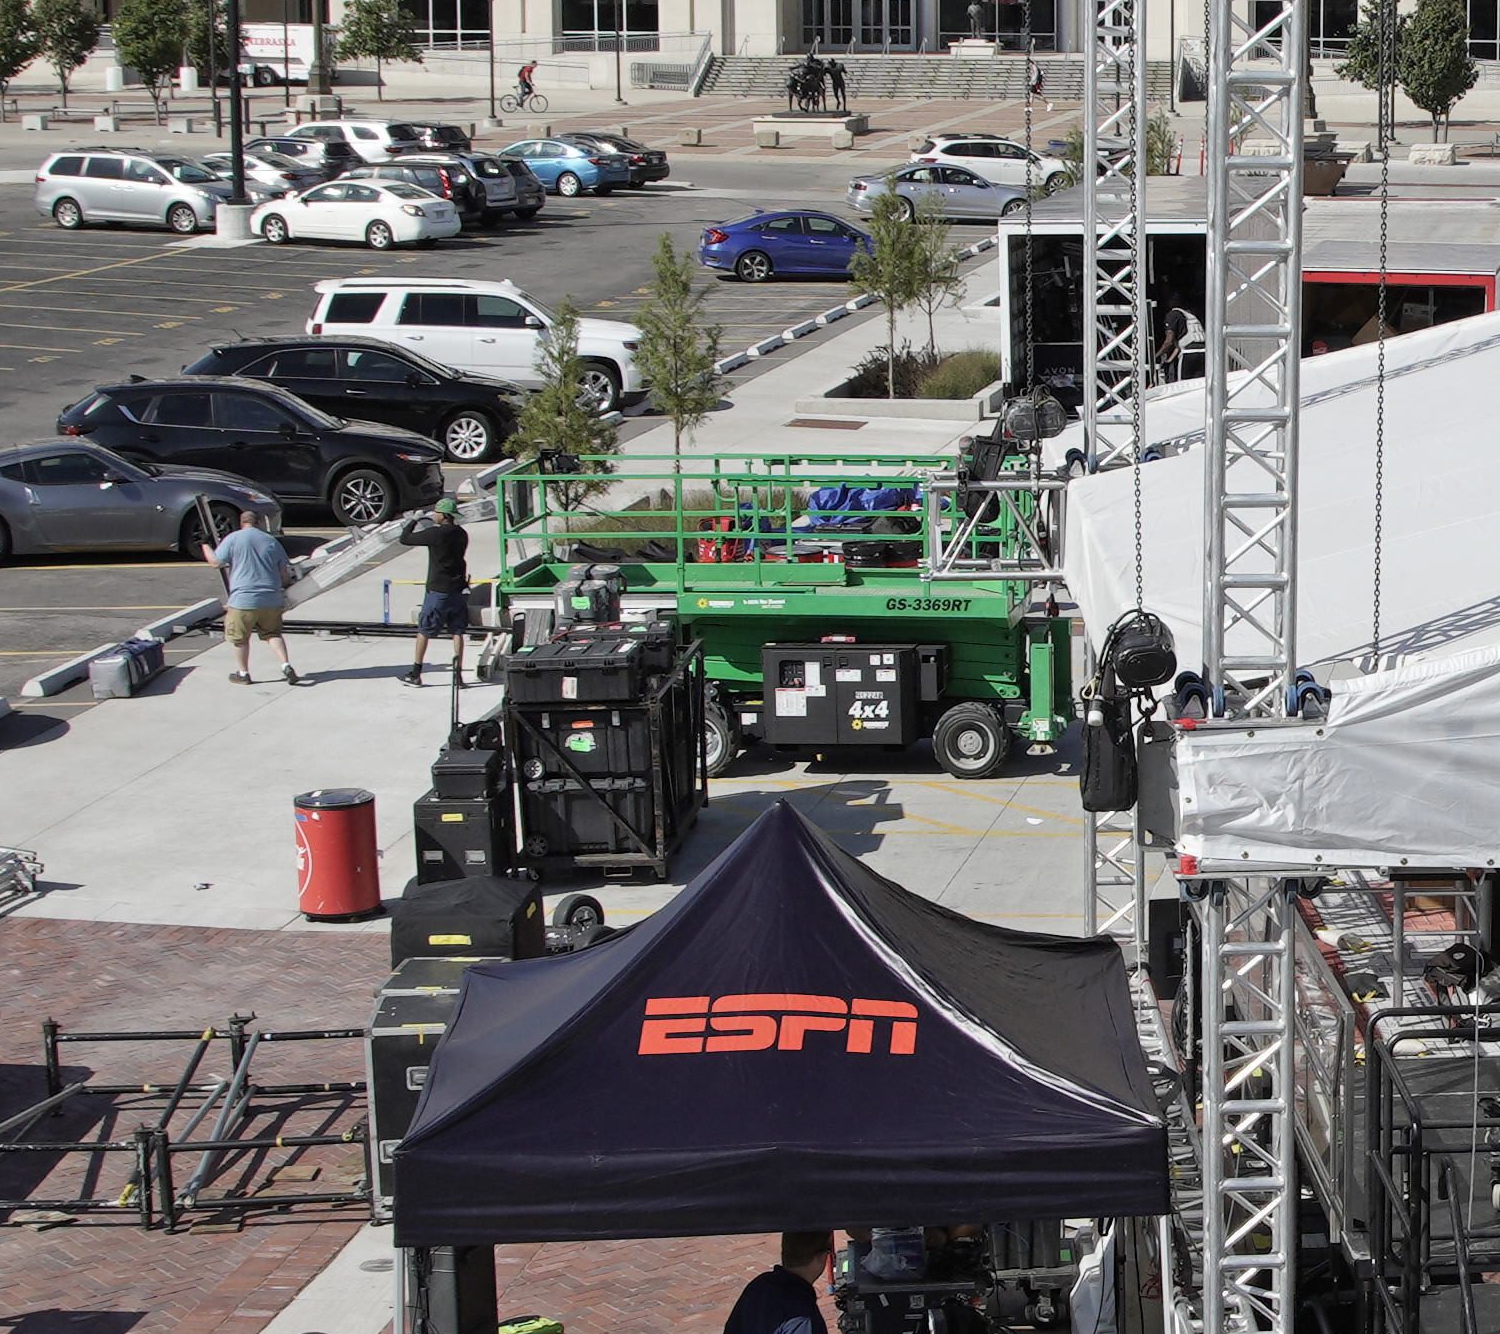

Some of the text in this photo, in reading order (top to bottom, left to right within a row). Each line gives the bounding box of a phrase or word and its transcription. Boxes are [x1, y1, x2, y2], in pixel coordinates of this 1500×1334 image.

[886, 598, 972, 612] GS-3369RT
[848, 700, 889, 718] 4x4
[637, 993, 919, 1056] ESPN
